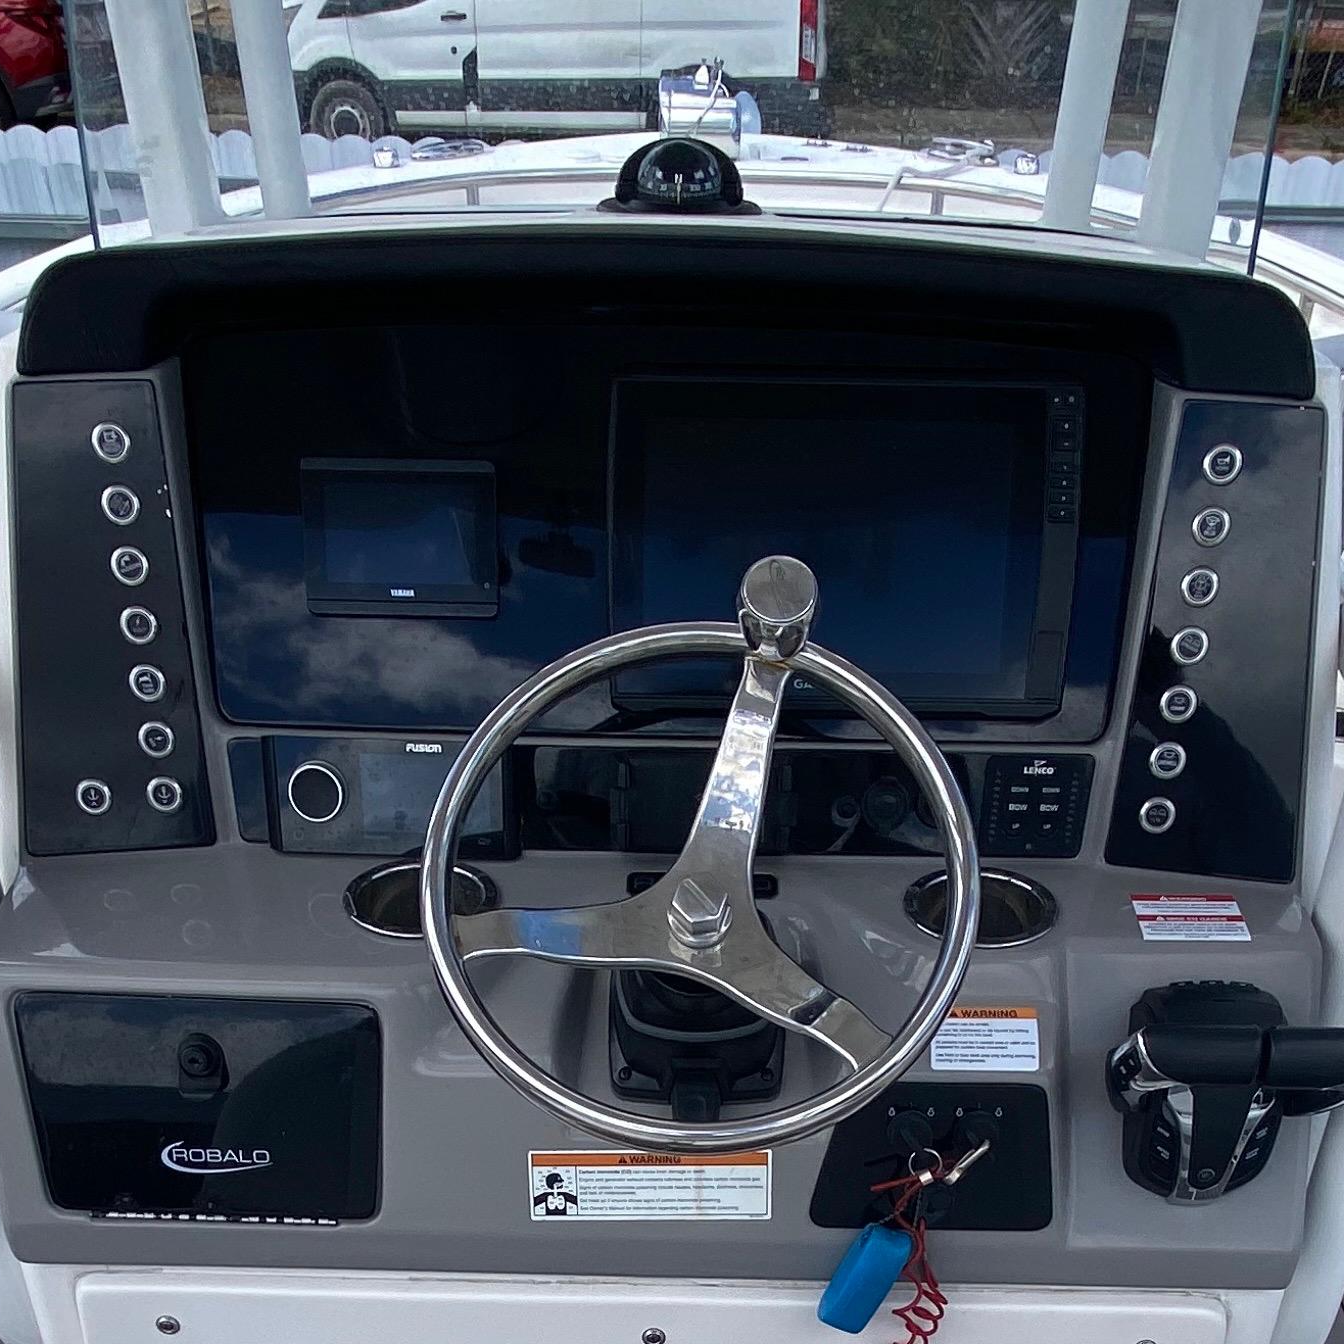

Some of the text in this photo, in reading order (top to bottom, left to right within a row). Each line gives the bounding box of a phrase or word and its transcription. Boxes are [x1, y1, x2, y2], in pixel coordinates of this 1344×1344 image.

[1023, 766, 1055, 775] LENCO
[960, 1009, 1019, 1018] WARNING
[172, 1148, 271, 1164] ROBALO
[628, 1155, 682, 1164] WARNING
